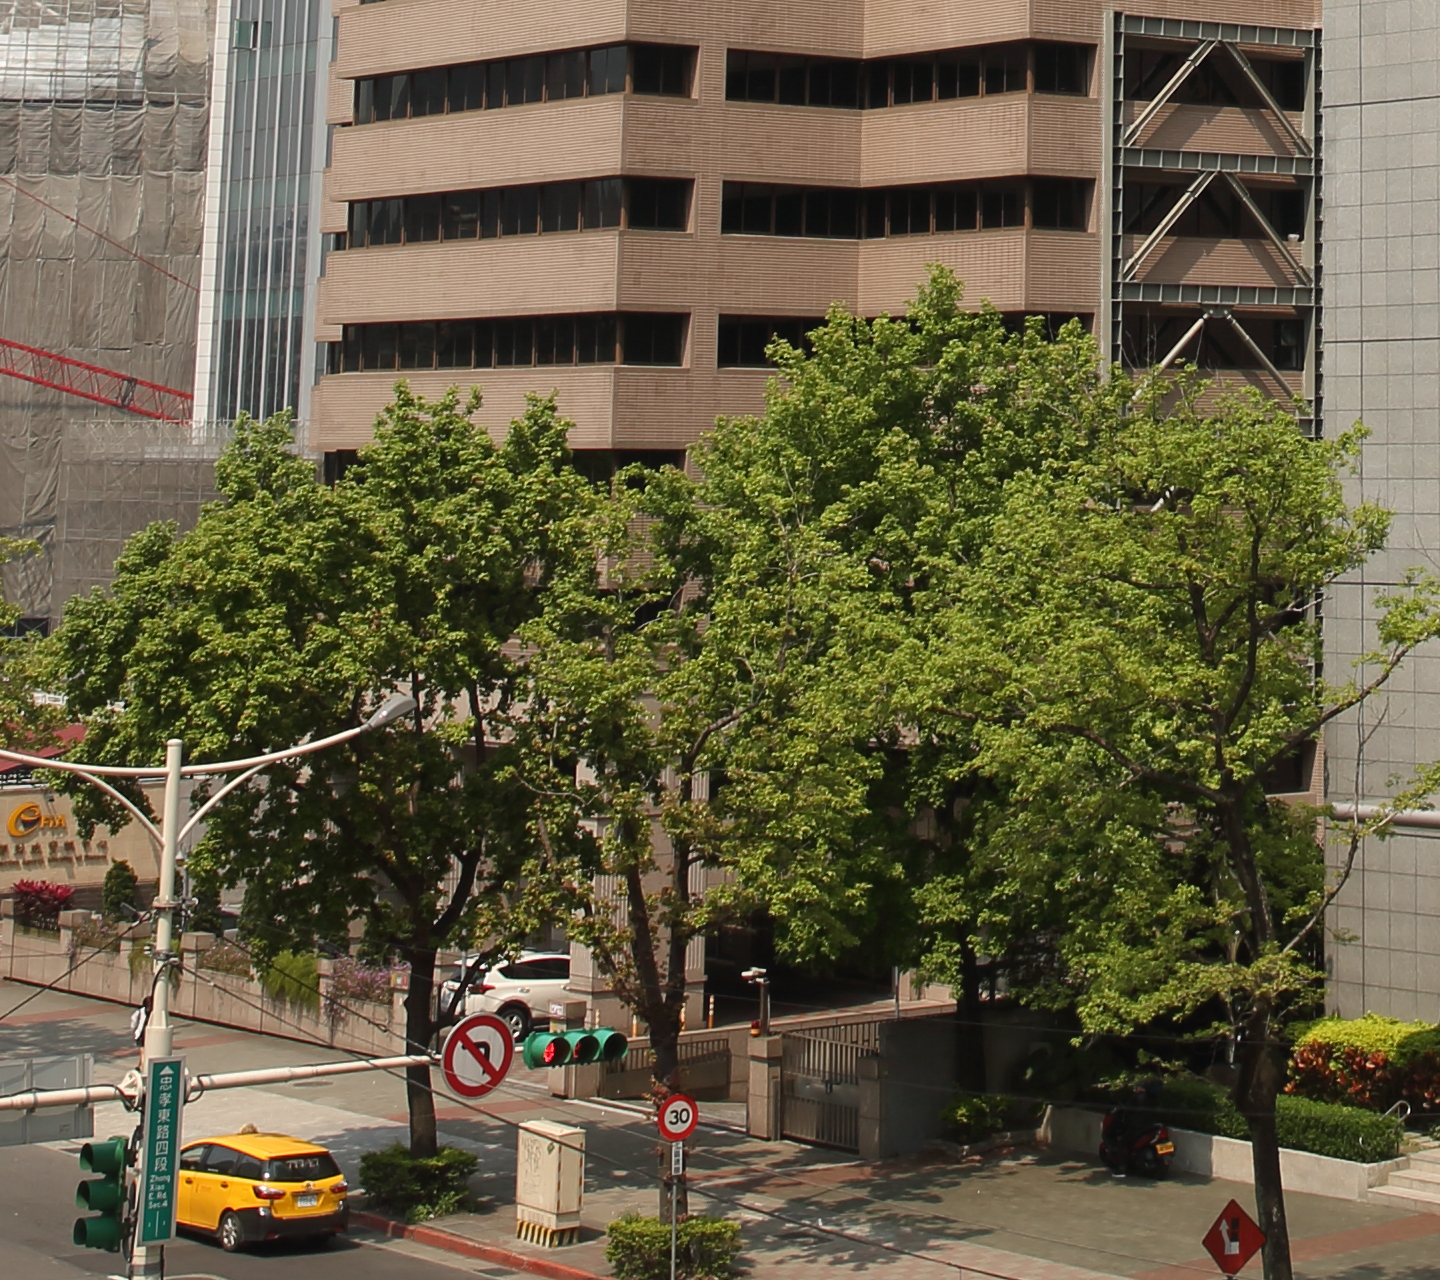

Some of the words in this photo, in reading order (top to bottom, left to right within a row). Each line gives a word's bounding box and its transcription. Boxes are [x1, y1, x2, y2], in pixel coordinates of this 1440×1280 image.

[154, 1076, 172, 1172] 忠孝東路四段
[669, 1108, 690, 1125] 30
[150, 1175, 170, 1183] Zhong
